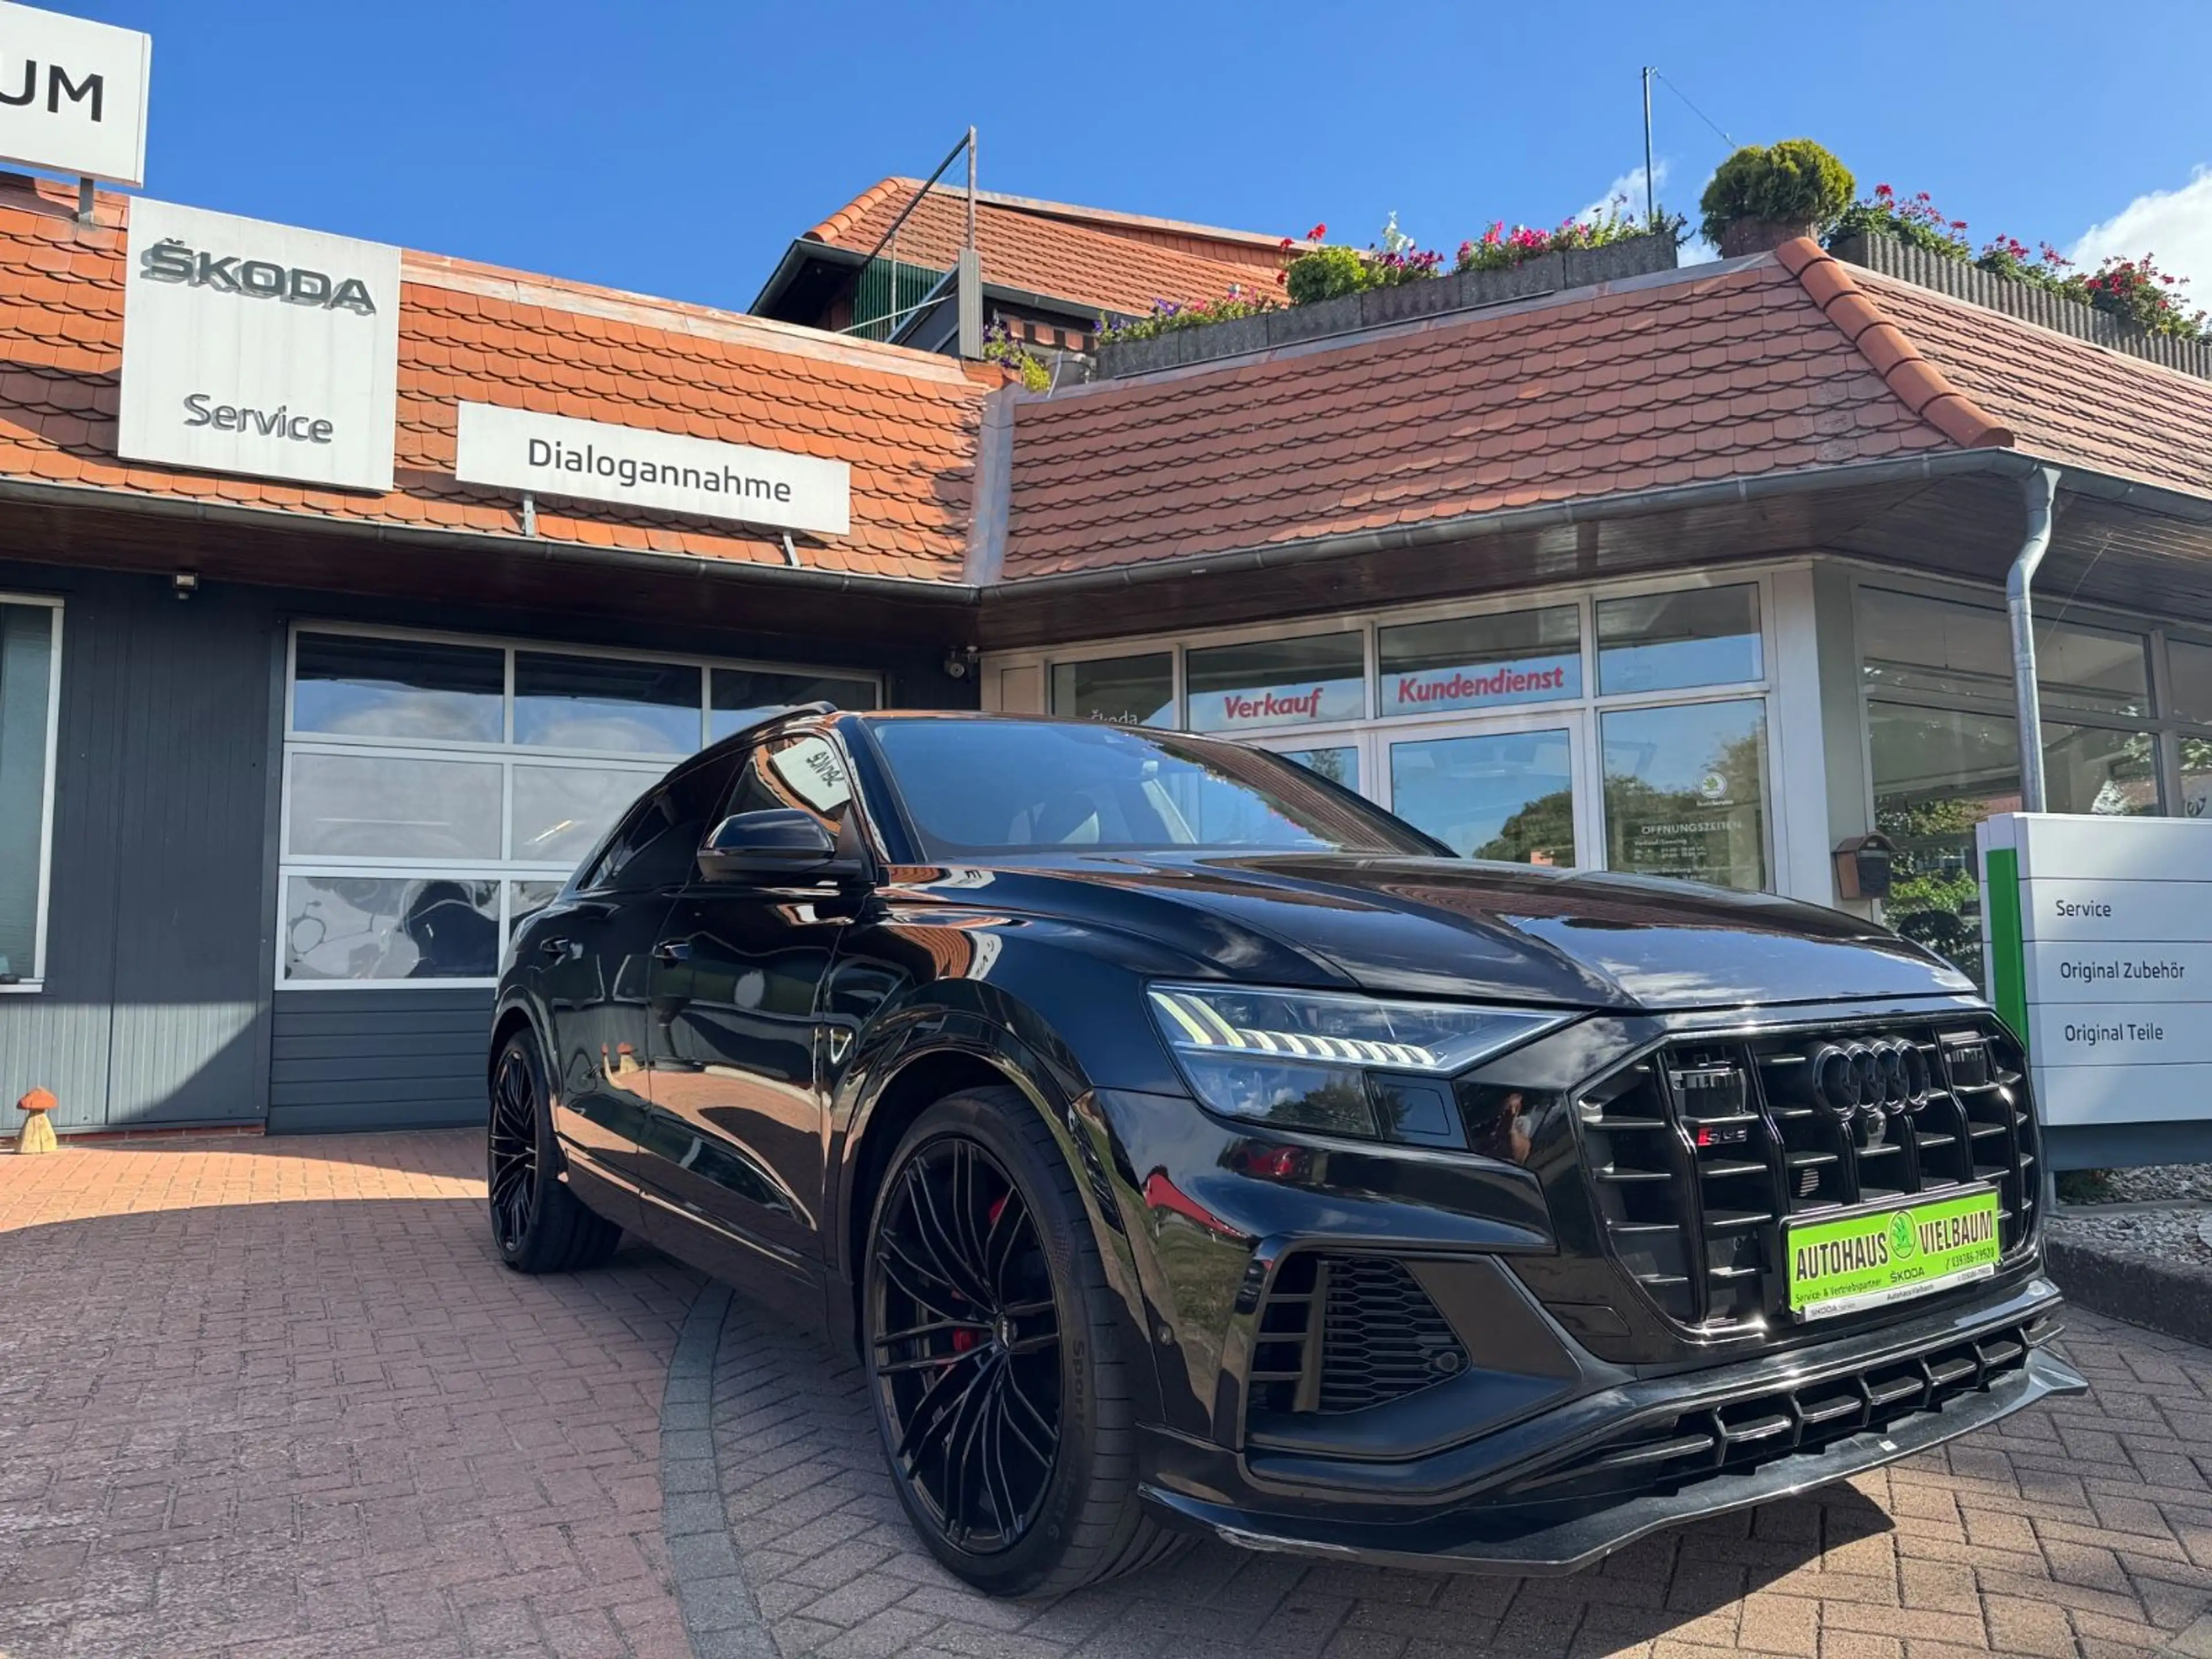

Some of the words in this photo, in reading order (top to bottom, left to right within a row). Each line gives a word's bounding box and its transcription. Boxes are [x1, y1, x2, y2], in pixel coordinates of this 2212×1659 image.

[144, 236, 376, 315] ŠKODA
[184, 393, 334, 444] Service
[529, 438, 791, 503] Dialogannahme
[1397, 666, 1564, 703] Kundendienst
[1224, 687, 1323, 719] Verkauf
[2055, 900, 2112, 918] Service
[2061, 961, 2119, 983] Original
[2123, 961, 2185, 979] Zubehör
[2065, 1024, 2123, 1046] Original
[2127, 1023, 2164, 1041] Teile
[1796, 1232, 1888, 1282] AUTOHAUS
[1919, 1210, 1993, 1255] VIELBAUM
[1890, 1266, 1925, 1283] ŠKODA
